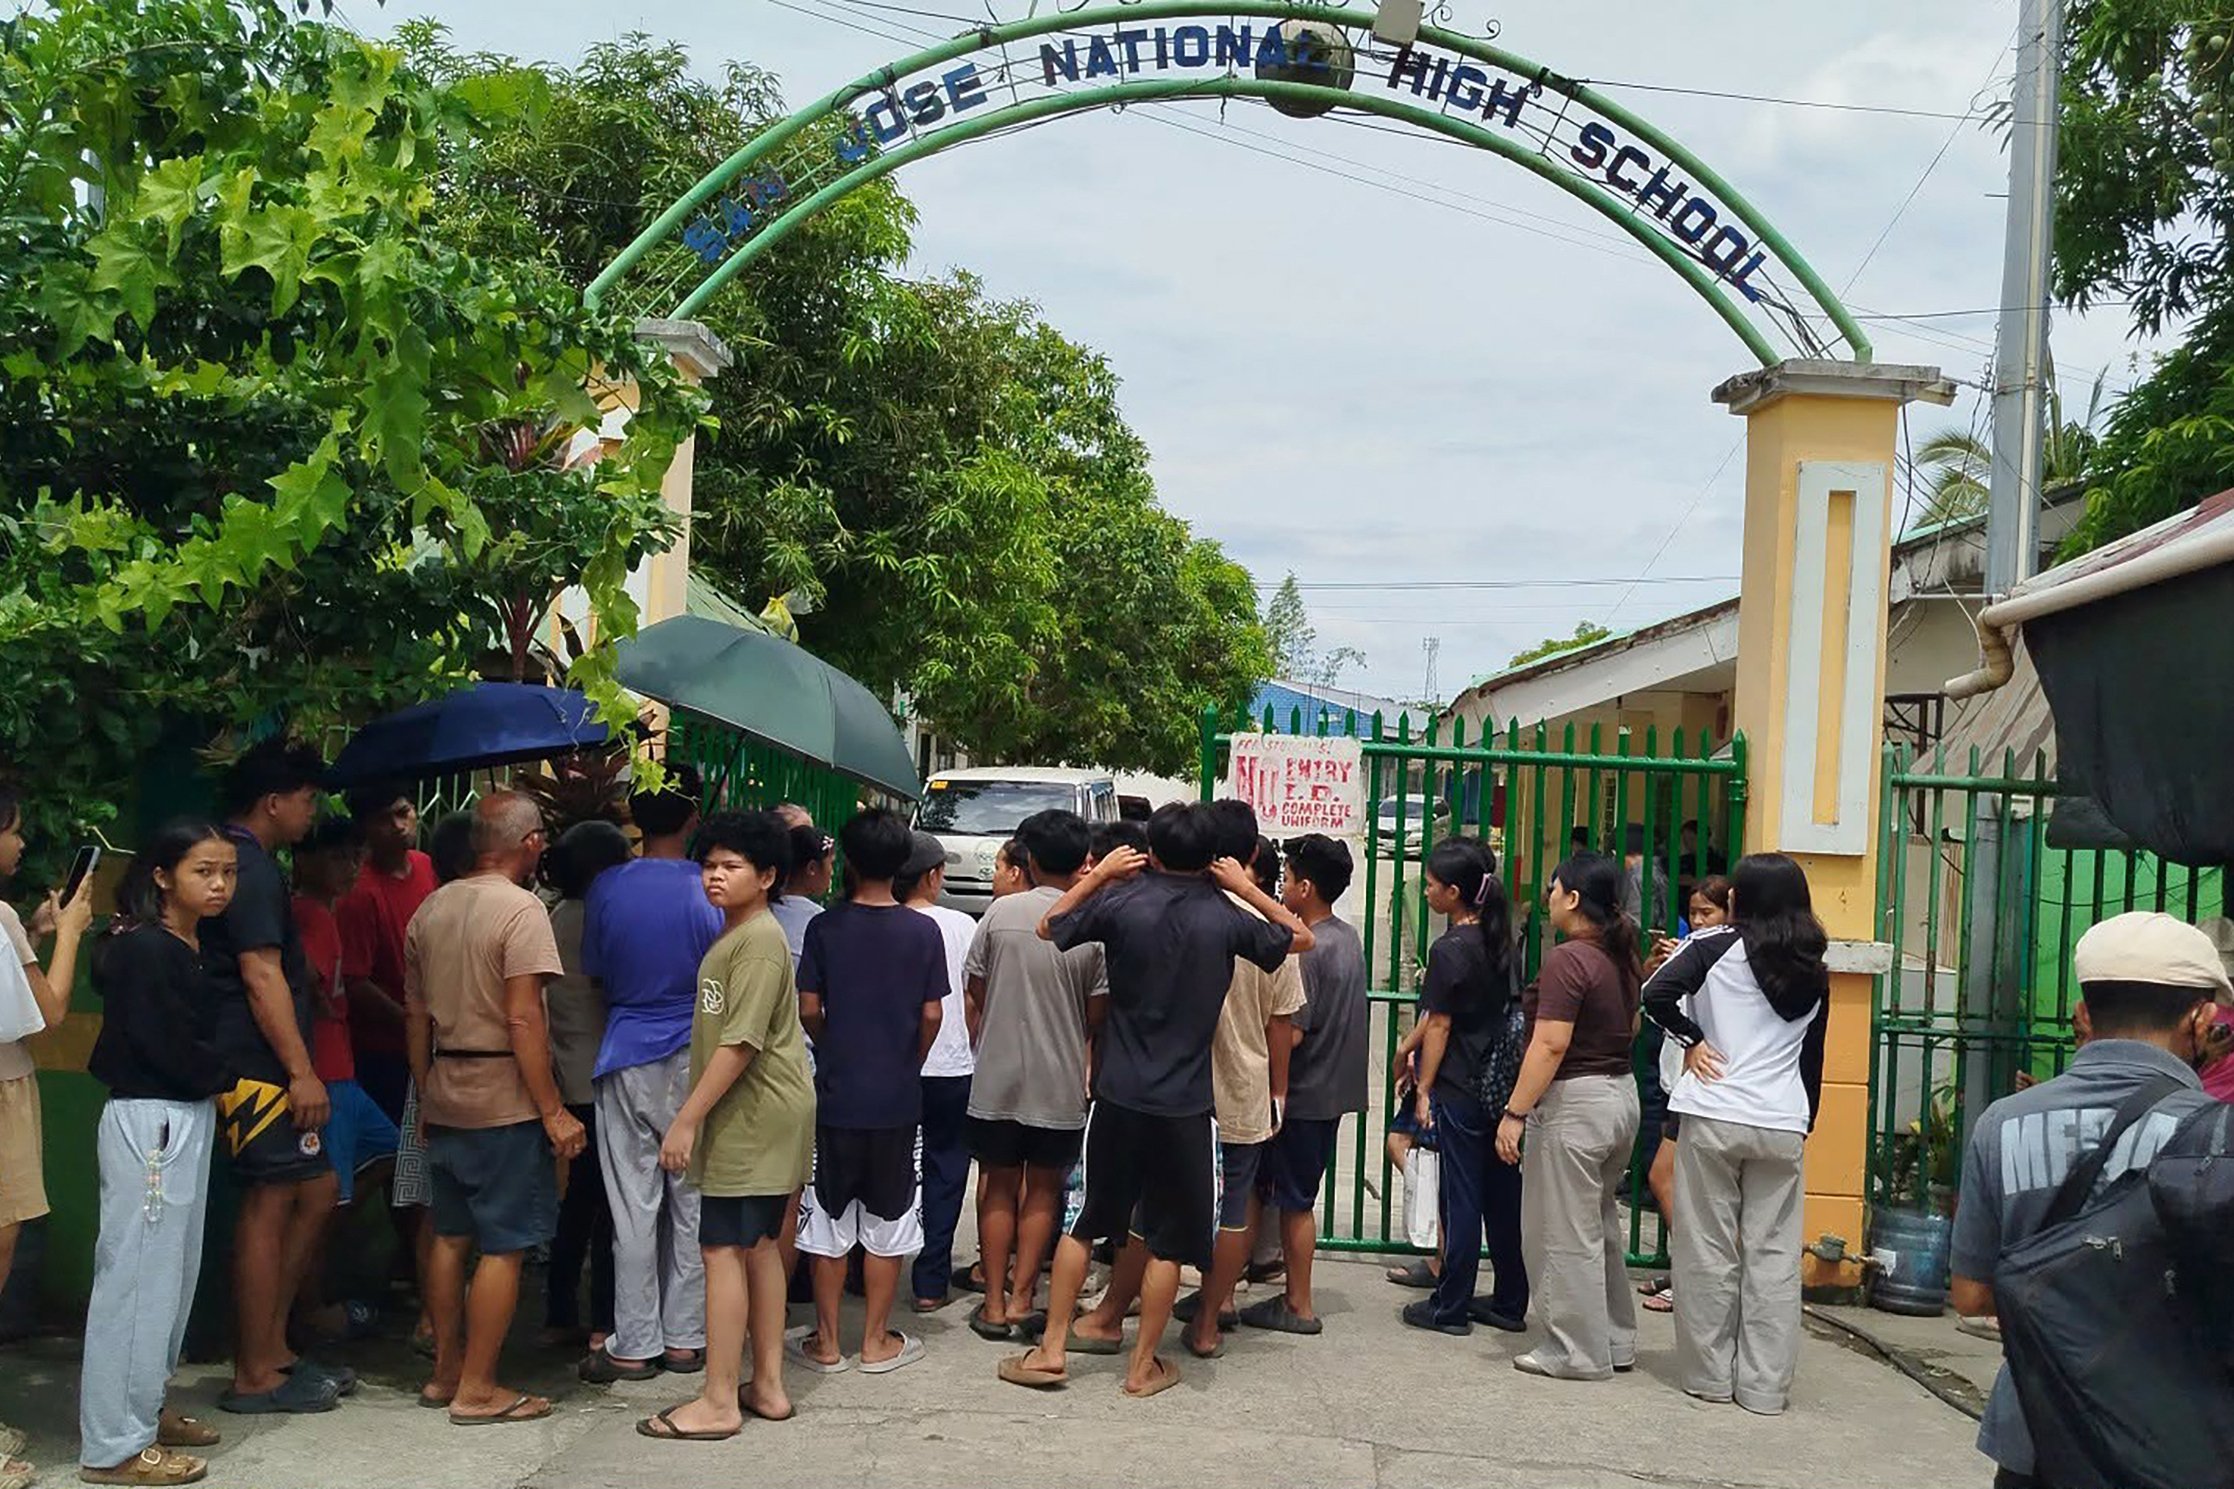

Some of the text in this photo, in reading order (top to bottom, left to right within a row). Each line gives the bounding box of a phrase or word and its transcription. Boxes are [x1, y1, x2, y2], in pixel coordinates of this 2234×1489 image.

[836, 63, 988, 162] JOSE
[1038, 24, 1330, 87] NATIONAL
[1387, 45, 1530, 128] HIGH
[1571, 122, 1767, 303] SCHOOL
[1286, 758, 1353, 783] ENTRY
[1282, 802, 1351, 818] COMPLETE
[1281, 815, 1344, 828] UNIFORM
